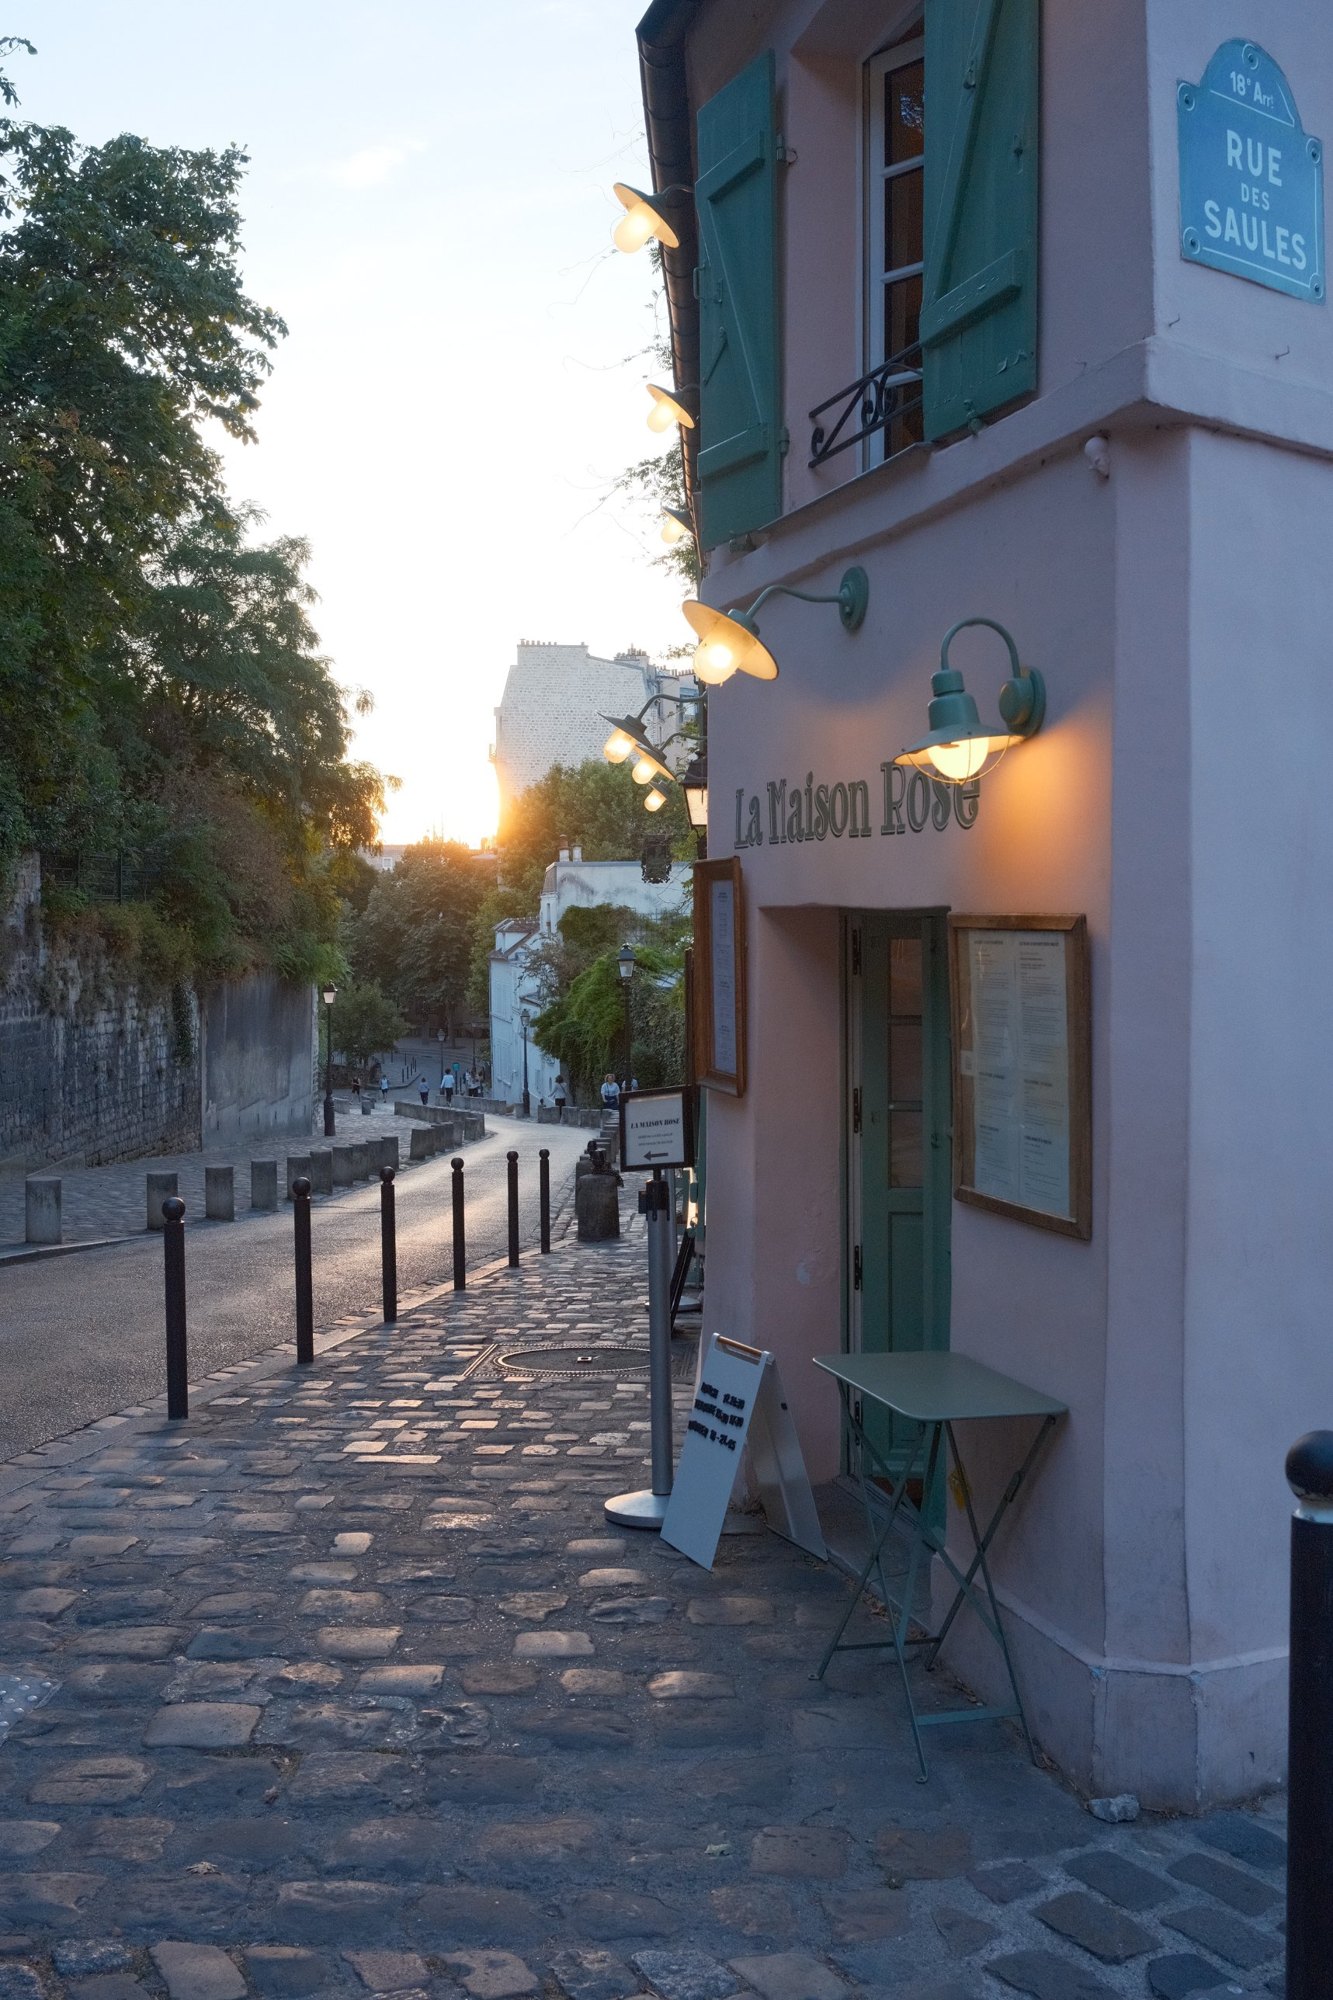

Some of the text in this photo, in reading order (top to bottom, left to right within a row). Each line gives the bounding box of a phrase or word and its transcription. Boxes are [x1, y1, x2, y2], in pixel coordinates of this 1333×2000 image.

[1226, 129, 1282, 187] RUE
[1241, 183, 1270, 210] DES
[1204, 199, 1307, 270] SAULES
[734, 761, 980, 849] La Maison Rose
[640, 1119, 663, 1128] MAISON
